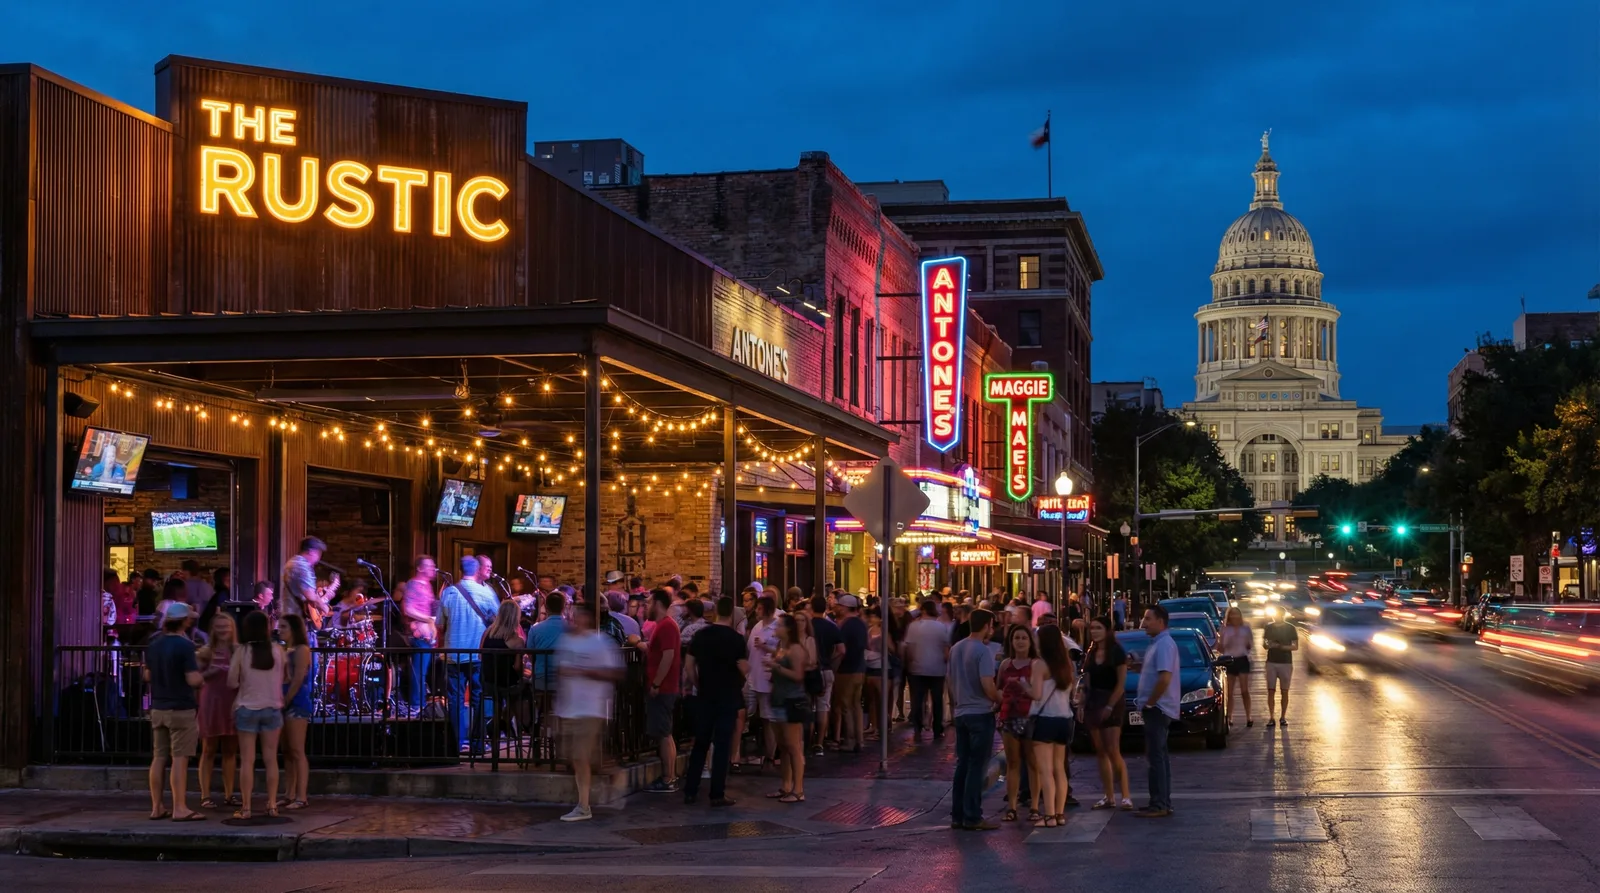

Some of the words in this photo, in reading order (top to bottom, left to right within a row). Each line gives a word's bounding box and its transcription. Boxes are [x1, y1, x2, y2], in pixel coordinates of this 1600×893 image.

[200, 98, 297, 147] THE
[200, 144, 510, 243] RUSTIC
[731, 326, 789, 384] ANTONE'S
[990, 380, 1048, 396] MAGGIE
